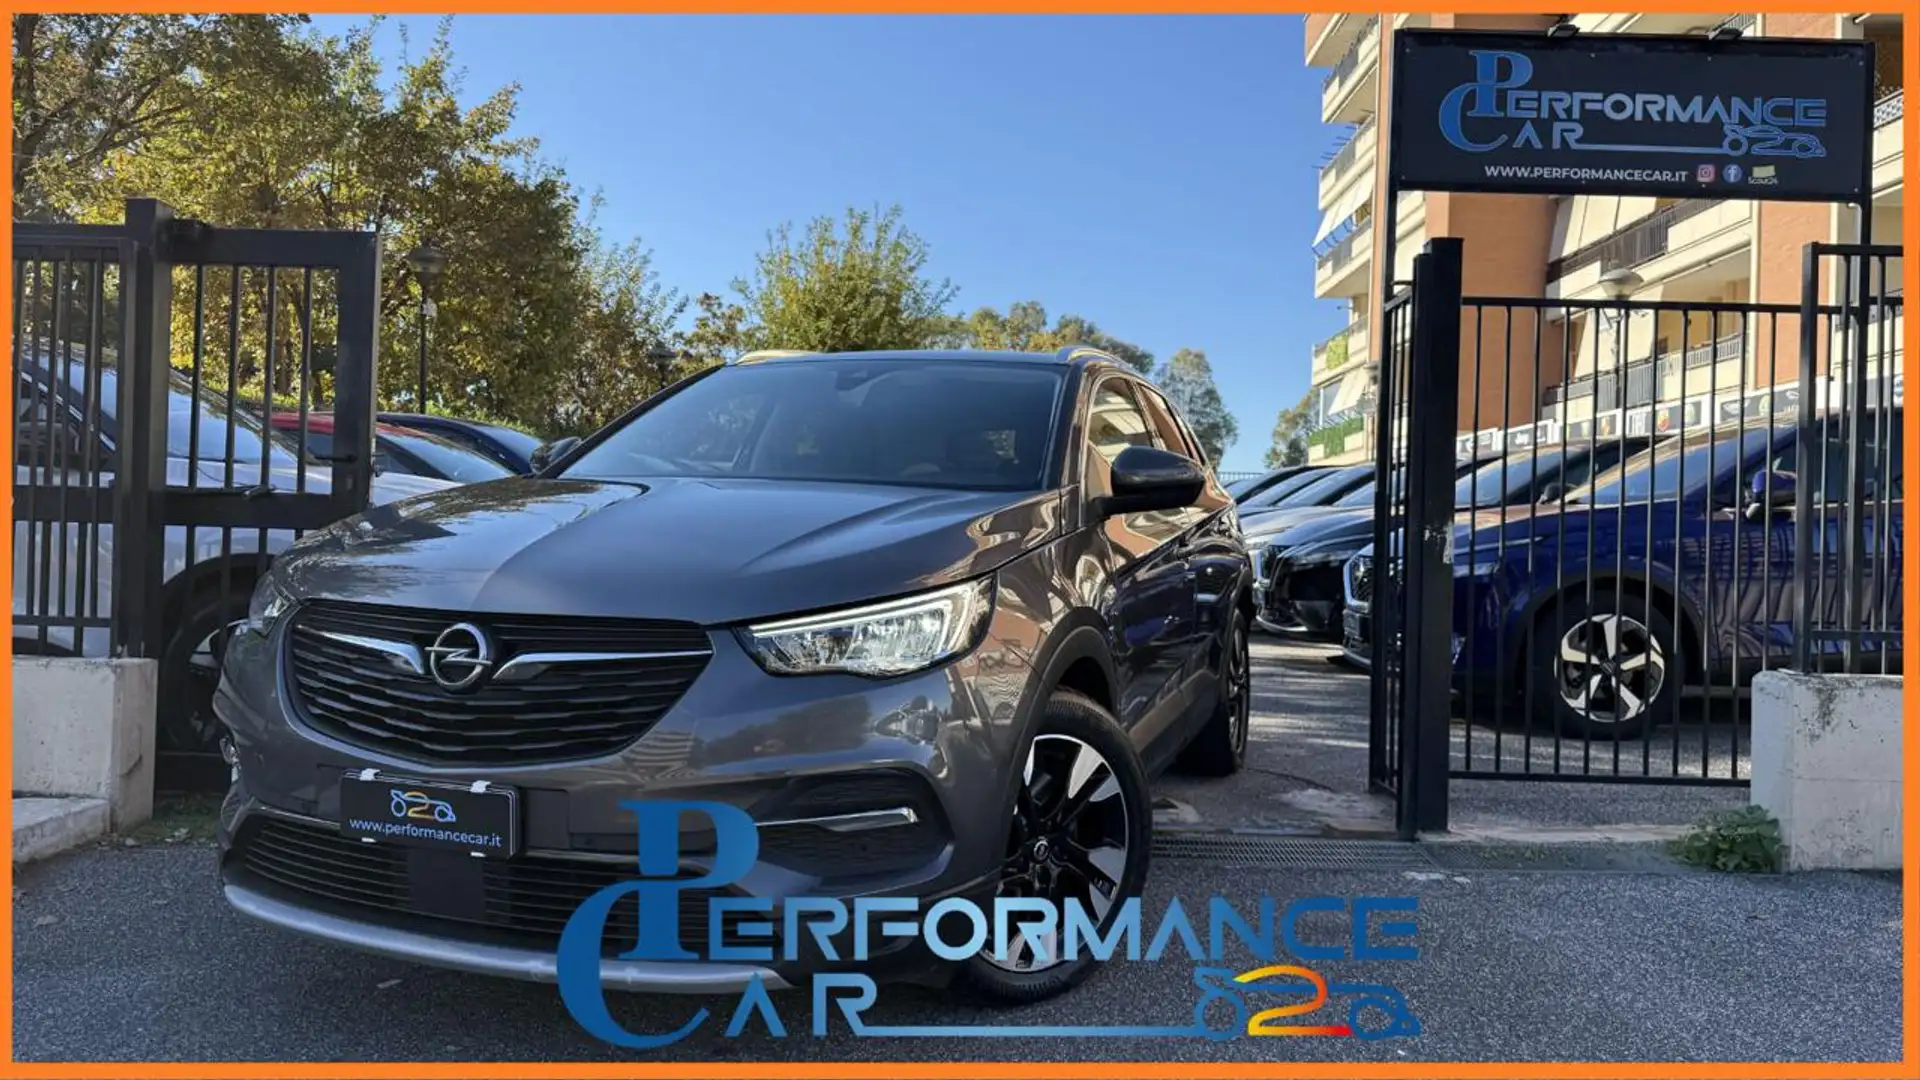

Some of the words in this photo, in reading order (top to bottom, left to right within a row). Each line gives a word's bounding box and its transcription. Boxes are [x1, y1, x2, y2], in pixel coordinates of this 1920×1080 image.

[1467, 50, 1827, 127] PERFORMANCE
[1438, 82, 1584, 152] CAR
[1484, 165, 1689, 182] WWW.PERFORMANCECAR.IT
[349, 818, 502, 848] www.performancecar.it
